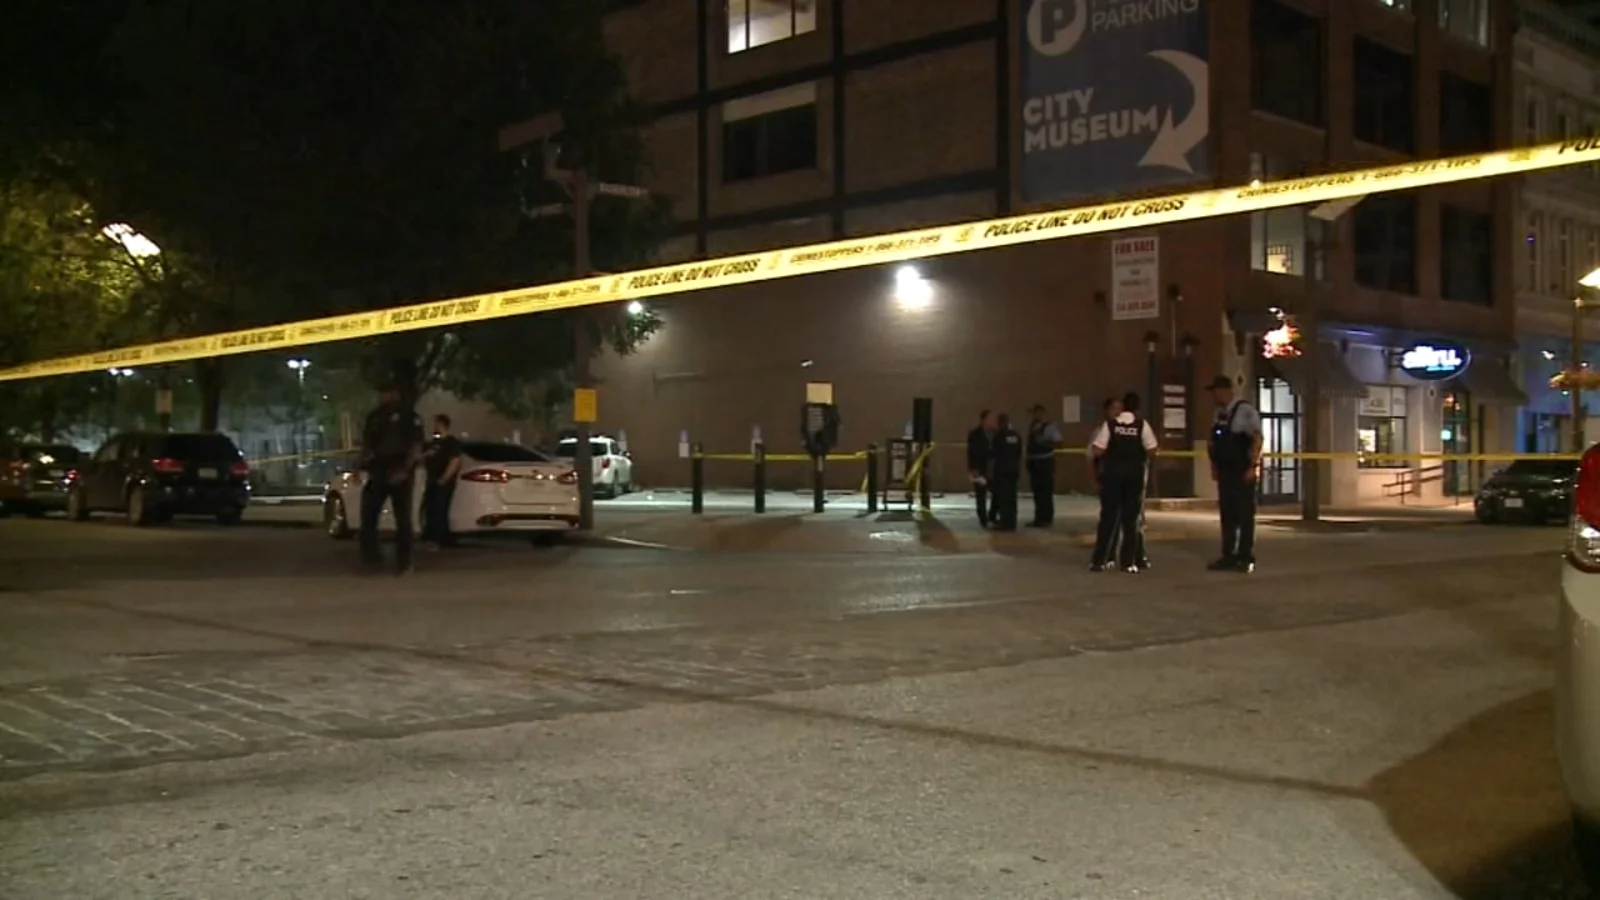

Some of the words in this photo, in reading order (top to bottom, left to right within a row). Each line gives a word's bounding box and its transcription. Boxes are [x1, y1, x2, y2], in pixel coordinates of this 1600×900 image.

[1092, 0, 1199, 34] PARKING
[1023, 87, 1094, 126] CITY
[1024, 105, 1158, 153] MUSEUM
[984, 218, 1036, 238] POLICE
[1037, 213, 1073, 230] LINE
[1073, 210, 1095, 225] DO
[1097, 205, 1132, 221] NOT
[1132, 197, 1189, 217] CROSS
[627, 272, 663, 290] POLICE
[662, 269, 686, 285] LINE
[701, 264, 725, 279] NOT
[723, 258, 761, 276] CROSS
[1114, 426, 1139, 436] POLICE
